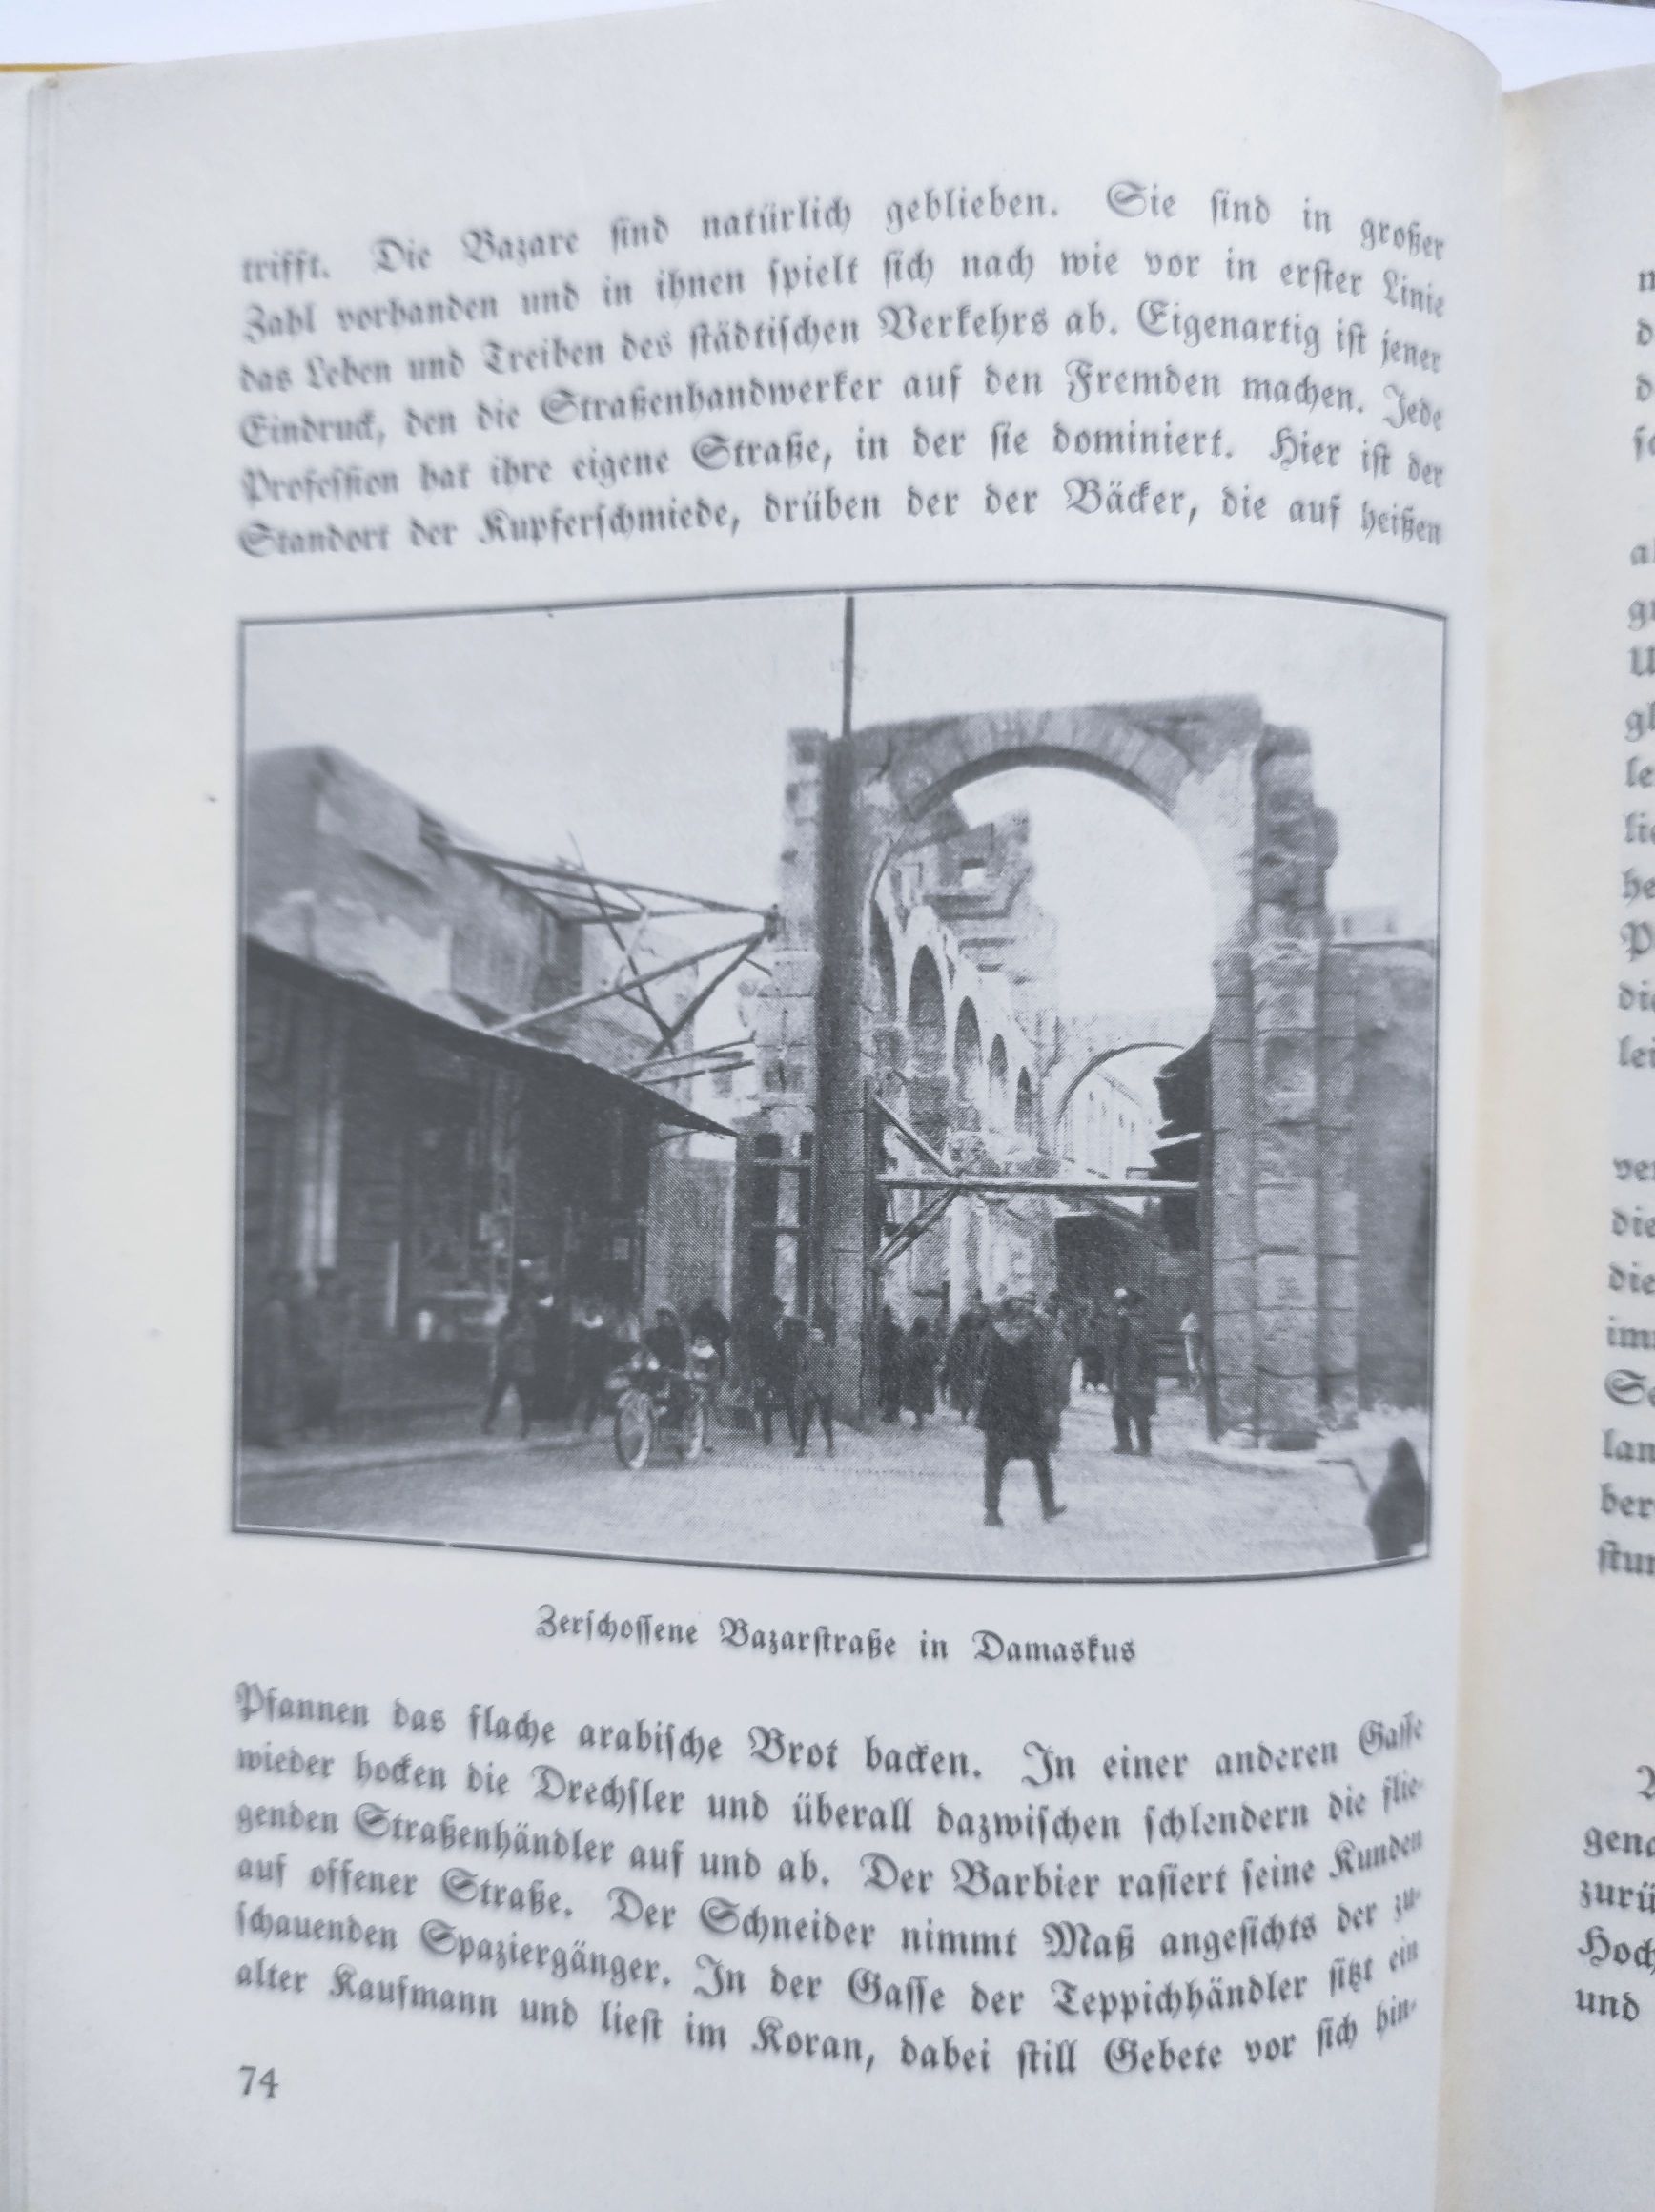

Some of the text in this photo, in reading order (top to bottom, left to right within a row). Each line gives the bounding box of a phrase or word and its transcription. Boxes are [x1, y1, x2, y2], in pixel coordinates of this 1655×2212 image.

[241, 178, 1445, 284] trifft. Die Bazare sind natürlich geblieben. Sie sind in großer
[243, 239, 1445, 345] Zahl vorhanden und in ihnen spielt sich nach wie vor in erster Linie
[238, 298, 1442, 393] das Leben und Treiben des städtischen Verkehrs ab. Eigenartig ist jener
[238, 358, 1443, 449] Eindruck, den die Straßenhandwerker auf den Fremden machen. Jede
[239, 419, 1445, 507] Profession hat ihre eigene Straße, in der sie dominiert. Hier ist der
[235, 475, 1443, 559] Standort der Kupferschmiede, drüben der der Bäcker, die auf heißen
[534, 1603, 1137, 1666] Zerschossene Bazarstraße in Damaskus
[234, 1680, 371, 1729] Pfannen
[391, 1697, 447, 1735] das
[467, 1702, 556, 1749] flache
[577, 1717, 723, 1766] arabische
[746, 1724, 839, 1772] Brot
[864, 1733, 983, 1781] backen.
[1020, 1739, 1077, 1790] In
[1101, 1743, 1190, 1783] einer
[1214, 1740, 1339, 1779] anderen
[235, 1741, 336, 1781] wieder
[353, 1749, 448, 1792] hocken
[465, 1760, 510, 1799] die
[530, 1764, 686, 1818] Drechsler
[706, 1789, 770, 1824] und
[791, 1790, 914, 1836] überall
[936, 1802, 1122, 1847] dazwischen
[1143, 1802, 1310, 1846] schlendern
[1327, 1784, 1368, 1823] die
[235, 1800, 1423, 1904] genden Straßenhändler auf und ab. Der Barbier rasiert seine Kunden
[235, 1852, 288, 1889] auf
[308, 1856, 419, 1899] offener
[439, 1867, 574, 1920] Straße.
[606, 1885, 677, 1933] Der
[698, 1896, 877, 1951] Schneider
[900, 1916, 1018, 1960] nimmt
[1041, 1920, 1135, 1964] Maß
[1159, 1912, 1318, 1964] angesichts
[1336, 1901, 1379, 1936] der
[234, 1899, 398, 1953] schauenden
[418, 1918, 672, 1989] Spaziergänger.
[692, 1953, 747, 2001] In
[769, 1963, 824, 2003] der
[970, 1980, 1026, 2018] der
[1050, 1970, 1309, 2025] Teppichhändler
[1388, 1940, 1420, 1974] ein
[1574, 1988, 1642, 2024] und
[234, 1956, 309, 1996] alter
[327, 1963, 499, 2020] Kaufmann
[519, 1997, 579, 2031] und
[600, 2000, 664, 2046] liest
[684, 2010, 728, 2053] im
[750, 2015, 876, 2075] Koran,
[899, 2034, 991, 2075] dabei
[1015, 2038, 1078, 2080] still
[1102, 2036, 1223, 2077] Gebete
[1243, 2033, 1297, 2066] vor
[1315, 2012, 1359, 2058] sich
[237, 2063, 280, 2100] 74
